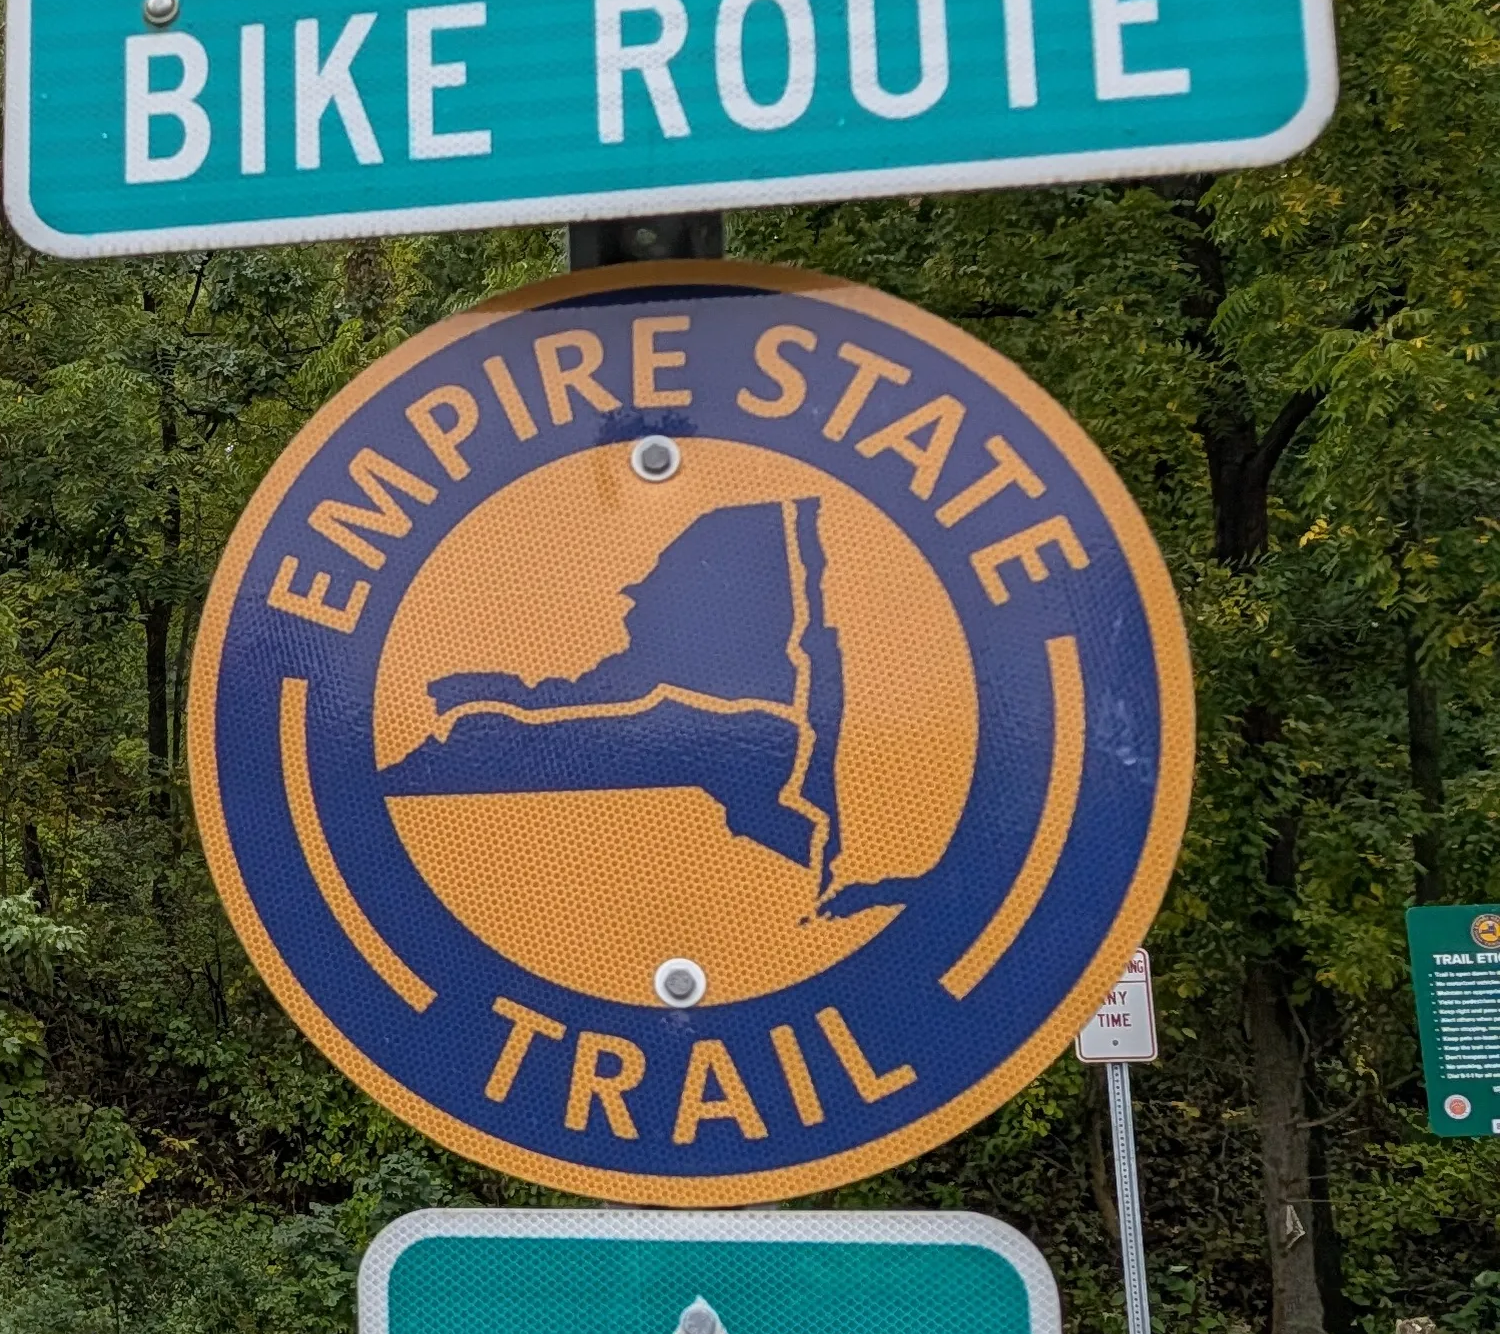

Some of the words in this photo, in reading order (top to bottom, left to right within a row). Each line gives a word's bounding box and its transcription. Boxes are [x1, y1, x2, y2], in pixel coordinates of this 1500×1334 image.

[124, 0, 493, 185] BIKE
[267, 315, 693, 633] EMPIRE
[736, 324, 1089, 605] STATE
[1097, 1013, 1132, 1028] TIME
[1433, 953, 1474, 965] TRAIL
[485, 995, 918, 1145] TRAIL
